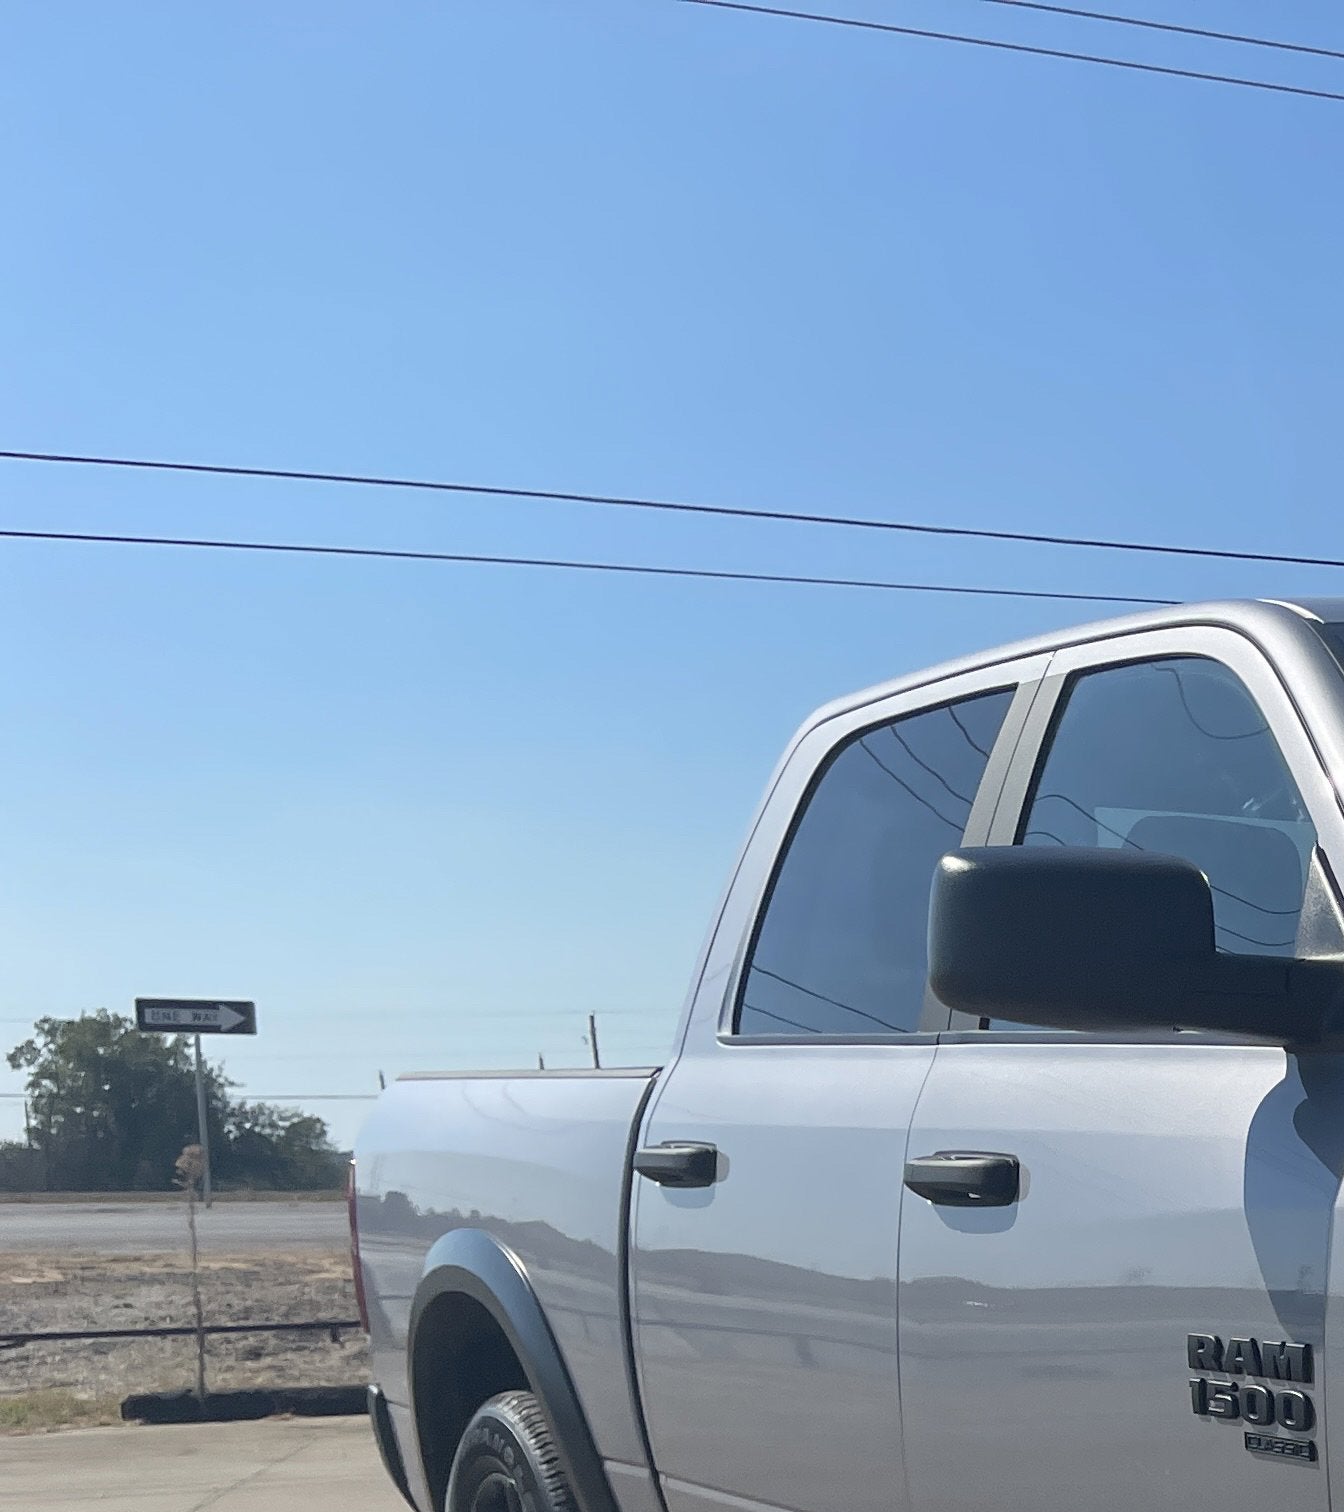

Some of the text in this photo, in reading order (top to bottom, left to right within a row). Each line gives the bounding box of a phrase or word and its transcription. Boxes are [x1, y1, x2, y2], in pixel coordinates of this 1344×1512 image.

[151, 1009, 218, 1021] ONE WAY
[1188, 1333, 1314, 1384] RAM
[1189, 1377, 1317, 1432] 1500
